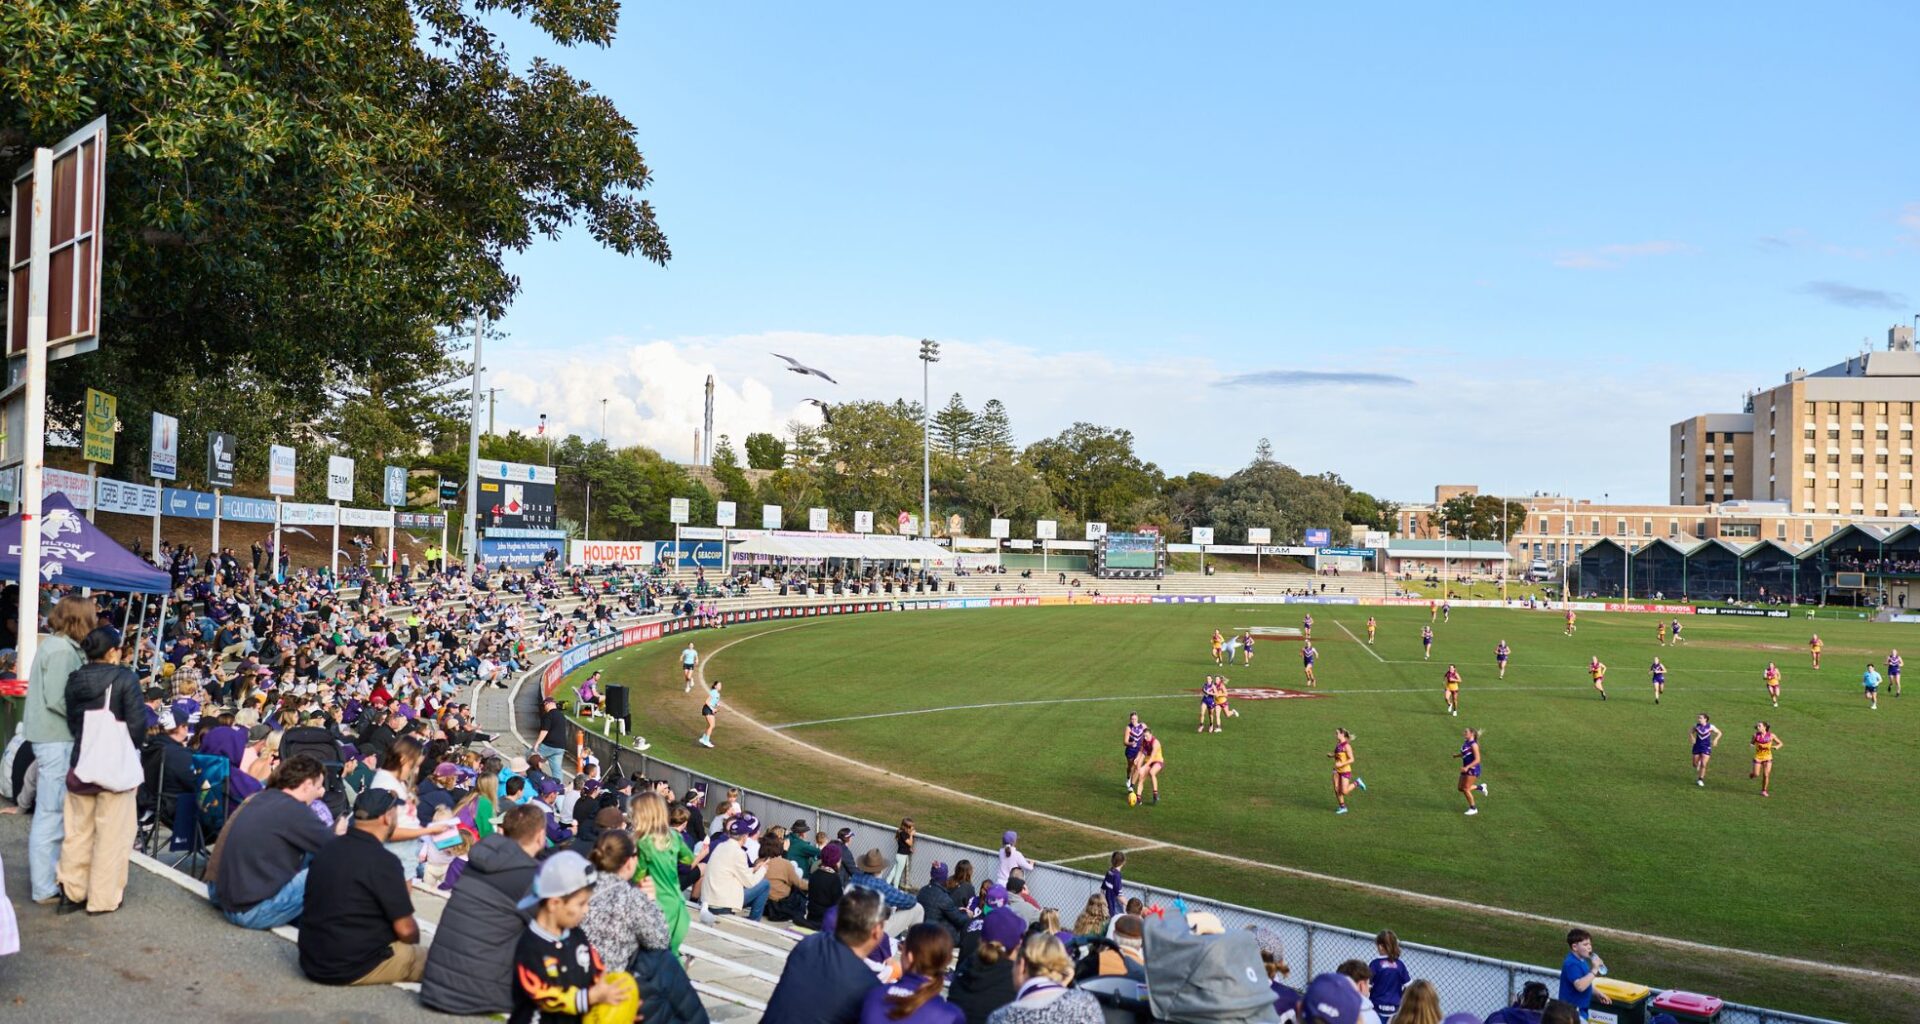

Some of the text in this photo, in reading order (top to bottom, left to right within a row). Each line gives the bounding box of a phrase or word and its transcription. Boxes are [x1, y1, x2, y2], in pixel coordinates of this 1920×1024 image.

[331, 474, 348, 484] TEAM
[584, 545, 642, 560] HOLDFAST
[664, 550, 689, 560] SEAORP
[698, 551, 722, 559] SEACORP
[483, 553, 498, 563] Your
[499, 555, 509, 563] car
[509, 553, 529, 564] buying
[1768, 609, 1788, 617] rebel
